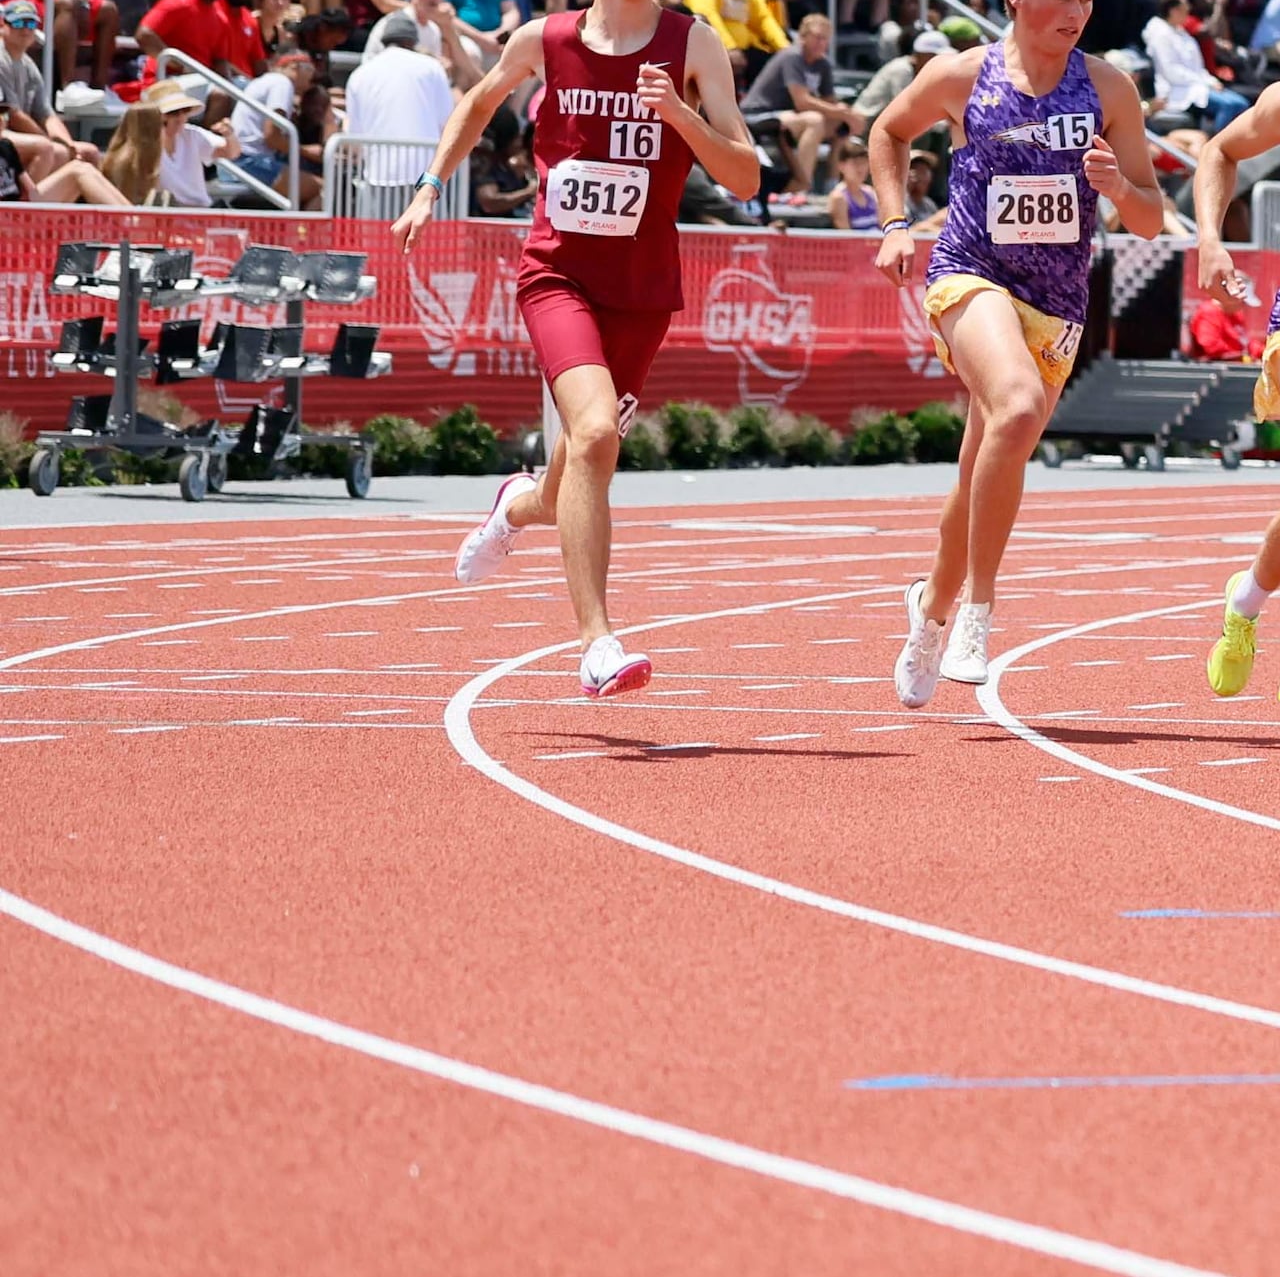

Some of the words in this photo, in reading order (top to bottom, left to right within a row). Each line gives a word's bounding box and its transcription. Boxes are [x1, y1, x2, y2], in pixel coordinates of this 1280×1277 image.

[615, 124, 653, 157] 16
[1052, 116, 1088, 148] 15
[560, 178, 641, 217] 3512
[997, 192, 1074, 224] 2688
[708, 300, 812, 345] GHSA
[1056, 323, 1081, 355] 15
